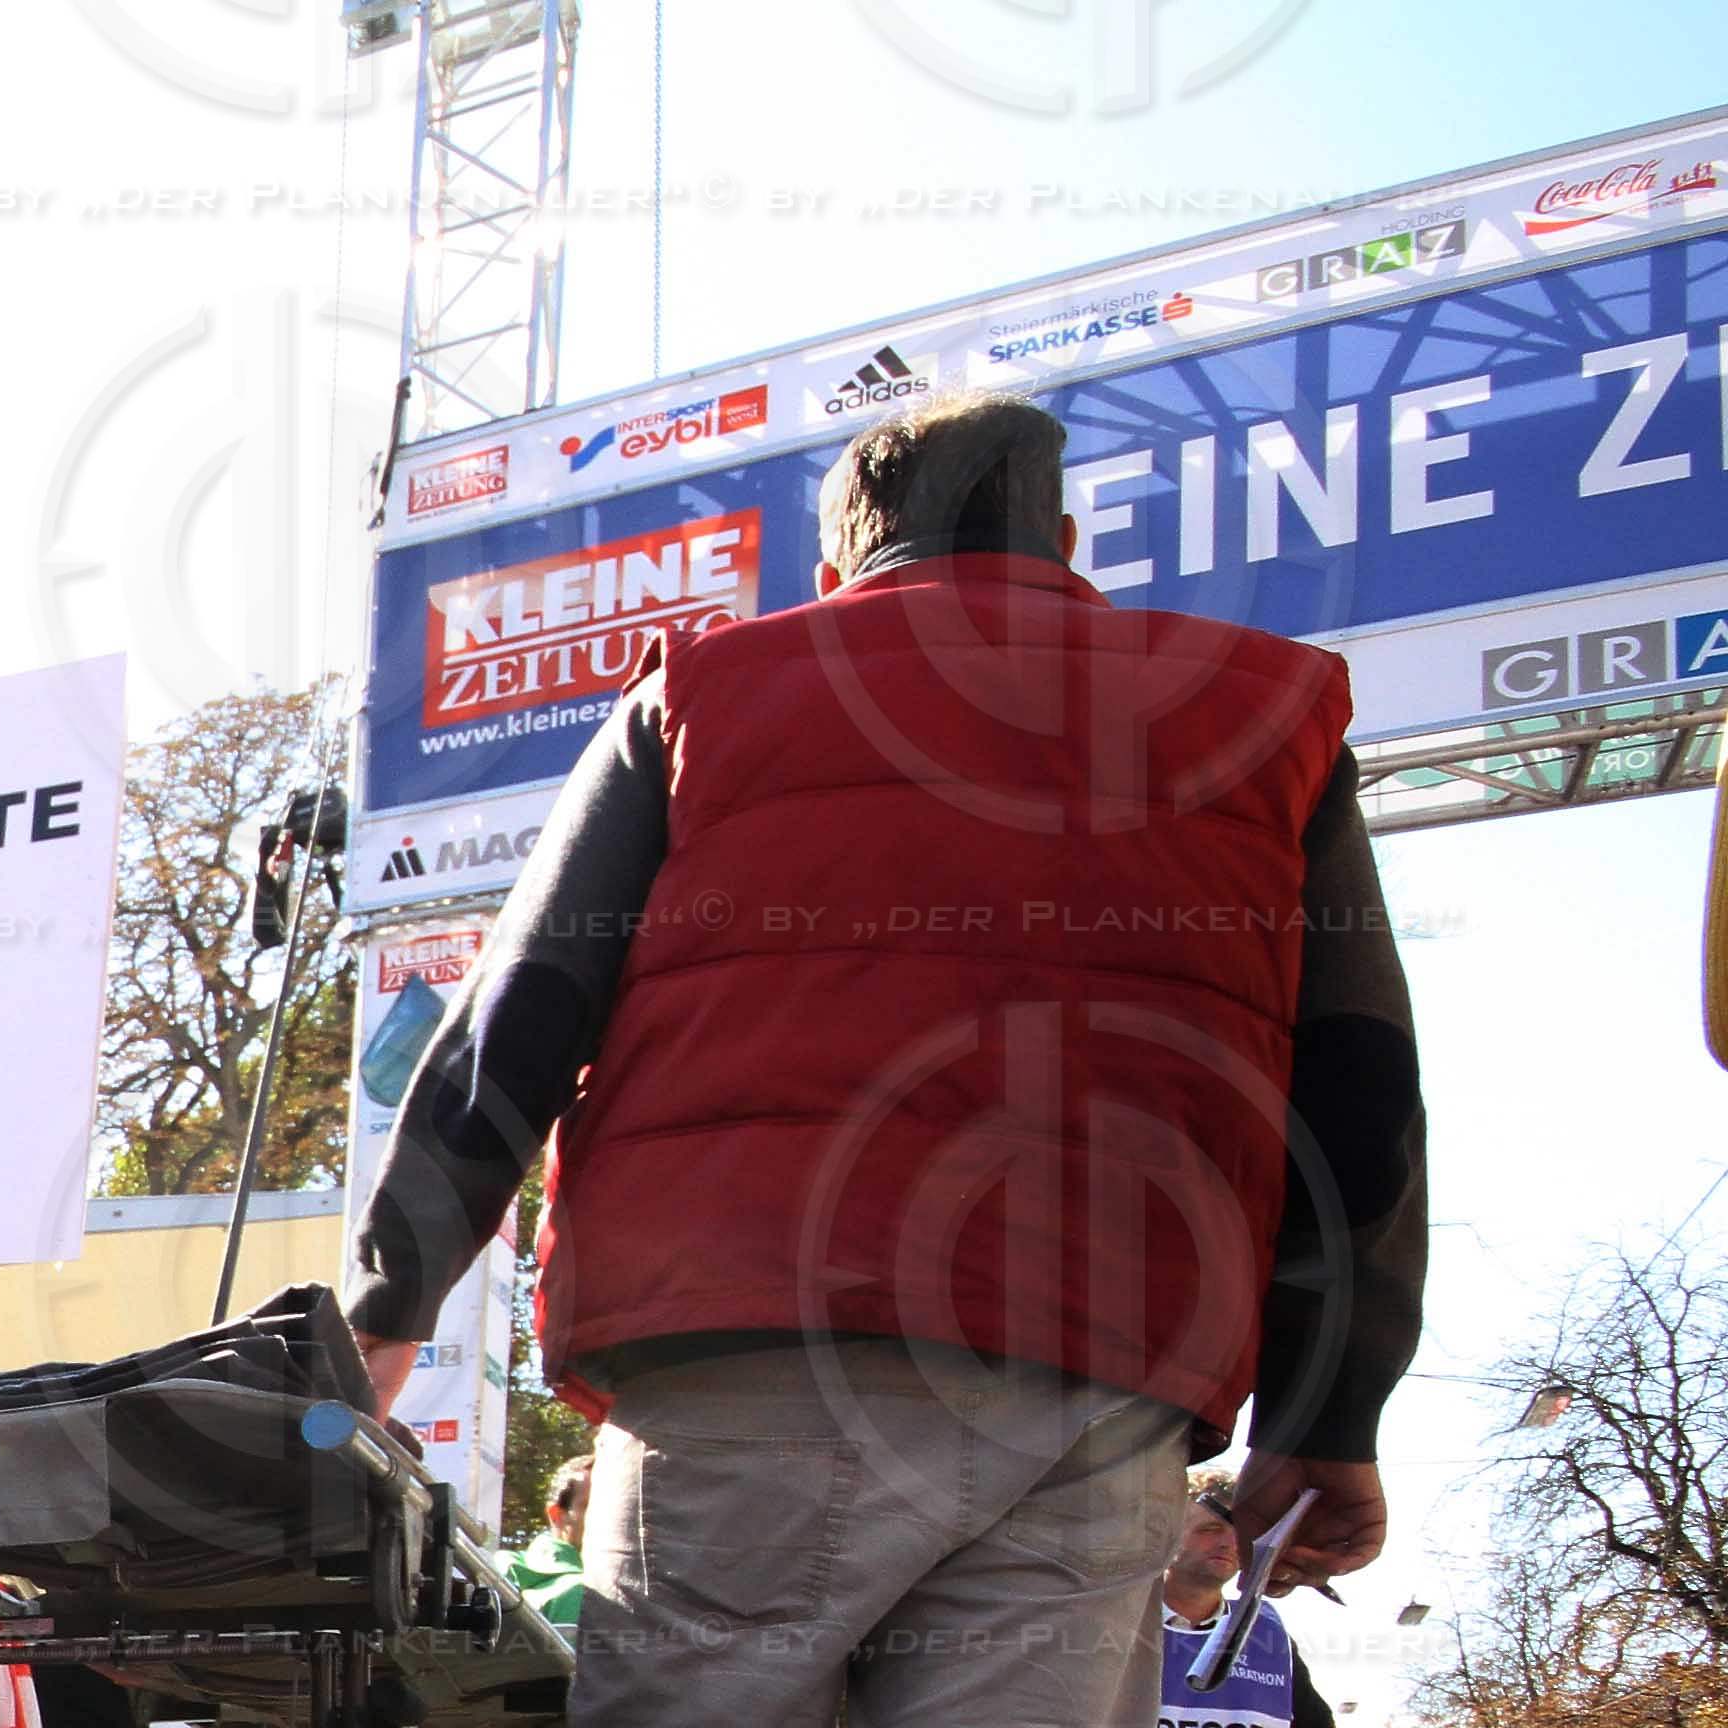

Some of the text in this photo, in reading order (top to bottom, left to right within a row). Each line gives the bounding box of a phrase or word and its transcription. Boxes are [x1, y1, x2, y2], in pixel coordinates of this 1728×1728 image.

[1534, 158, 1663, 216] Coca-Cola
[1380, 204, 1466, 235] HOLDING
[1259, 222, 1458, 299] GRAZ
[988, 305, 1159, 365] SPARKASSE
[617, 398, 715, 434] INTERSPORT
[824, 374, 929, 416] adidas
[1577, 324, 1728, 498] Z
[619, 411, 714, 460] eybl
[414, 450, 504, 492] KLEINE
[414, 473, 504, 511] ZEITUNG
[443, 527, 742, 653] KLEINE
[437, 606, 742, 712] ZEITU
[383, 934, 480, 970] KLEINE
